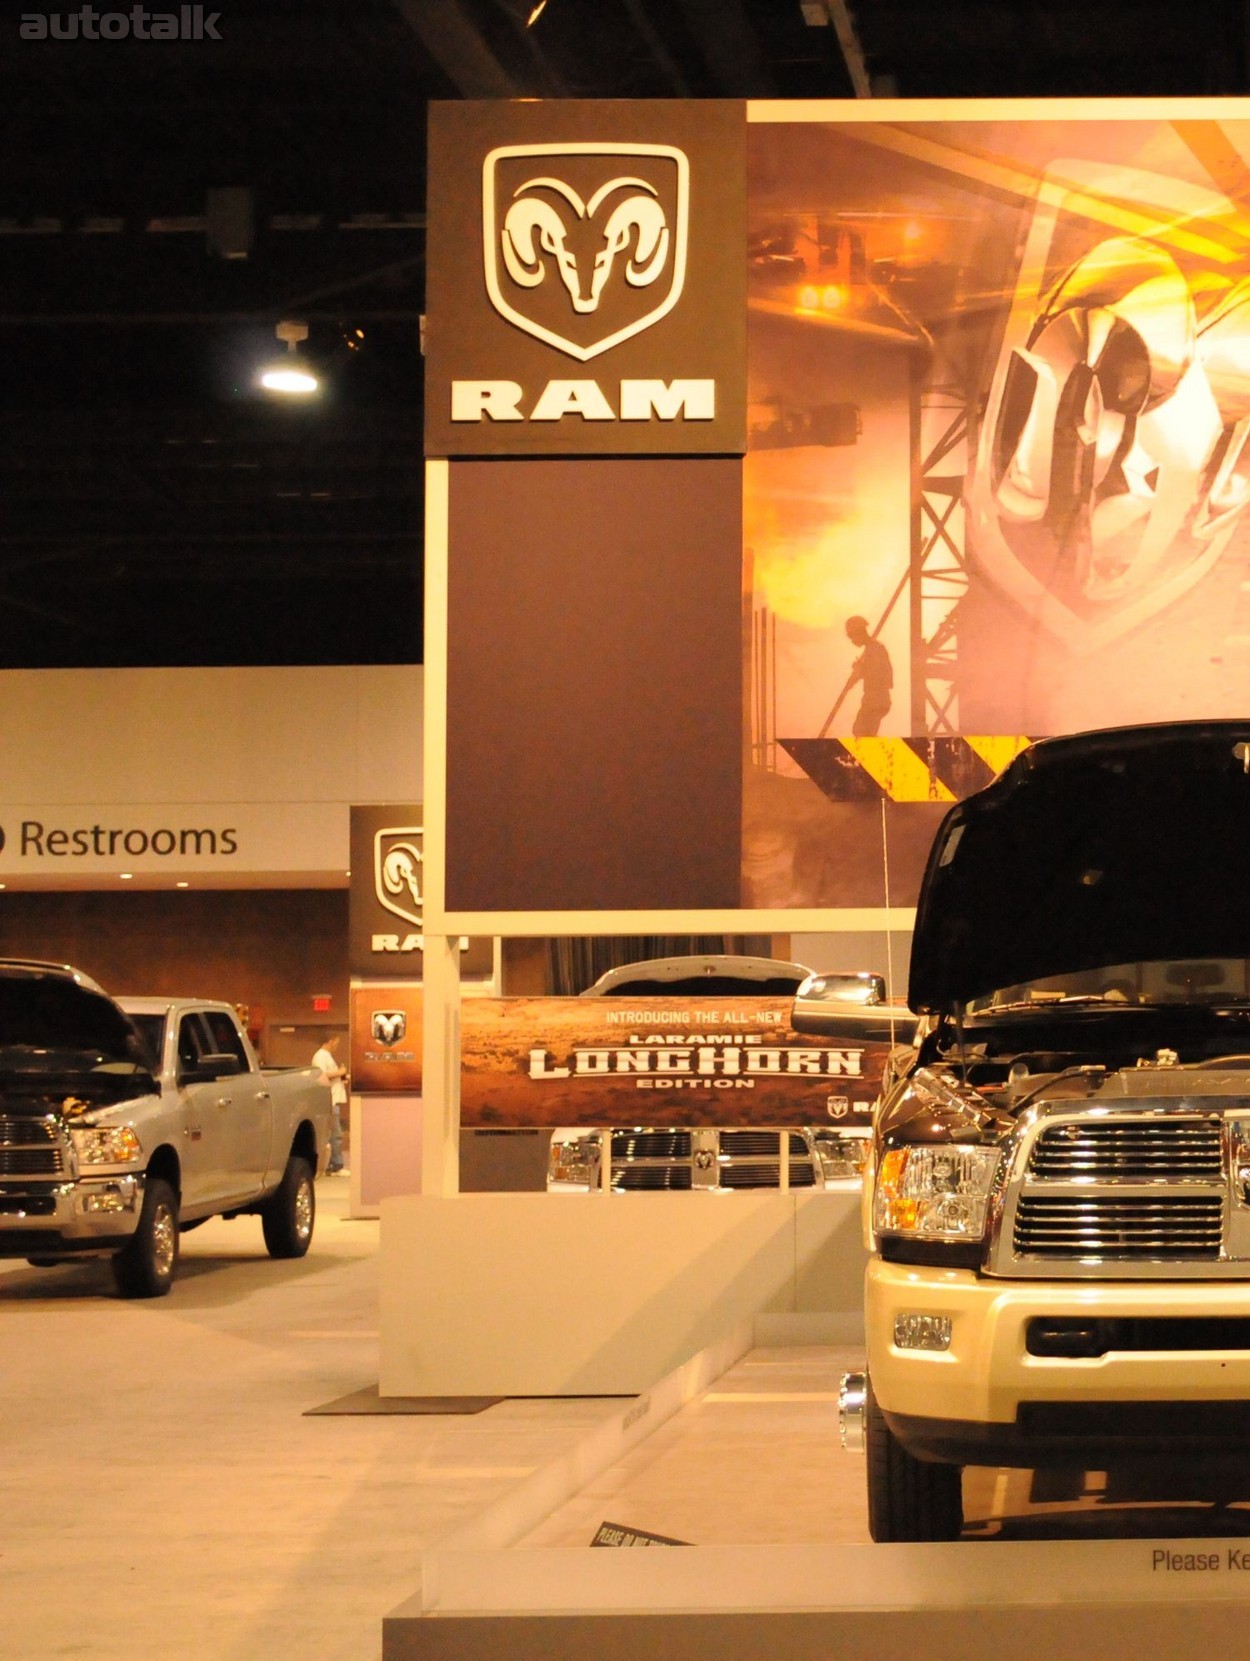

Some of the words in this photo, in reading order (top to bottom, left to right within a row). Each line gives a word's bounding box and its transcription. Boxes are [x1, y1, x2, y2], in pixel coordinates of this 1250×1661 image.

[451, 379, 715, 421] RAM
[20, 822, 237, 856] Restrooms
[371, 934, 469, 951] RA
[606, 1011, 690, 1023] INTRODUCING
[694, 1011, 719, 1023] THE
[723, 1010, 782, 1023] ALL-NEW
[629, 1034, 762, 1044] LARAMIE
[636, 1079, 755, 1089] EDITION
[1152, 1550, 1220, 1571] Please
